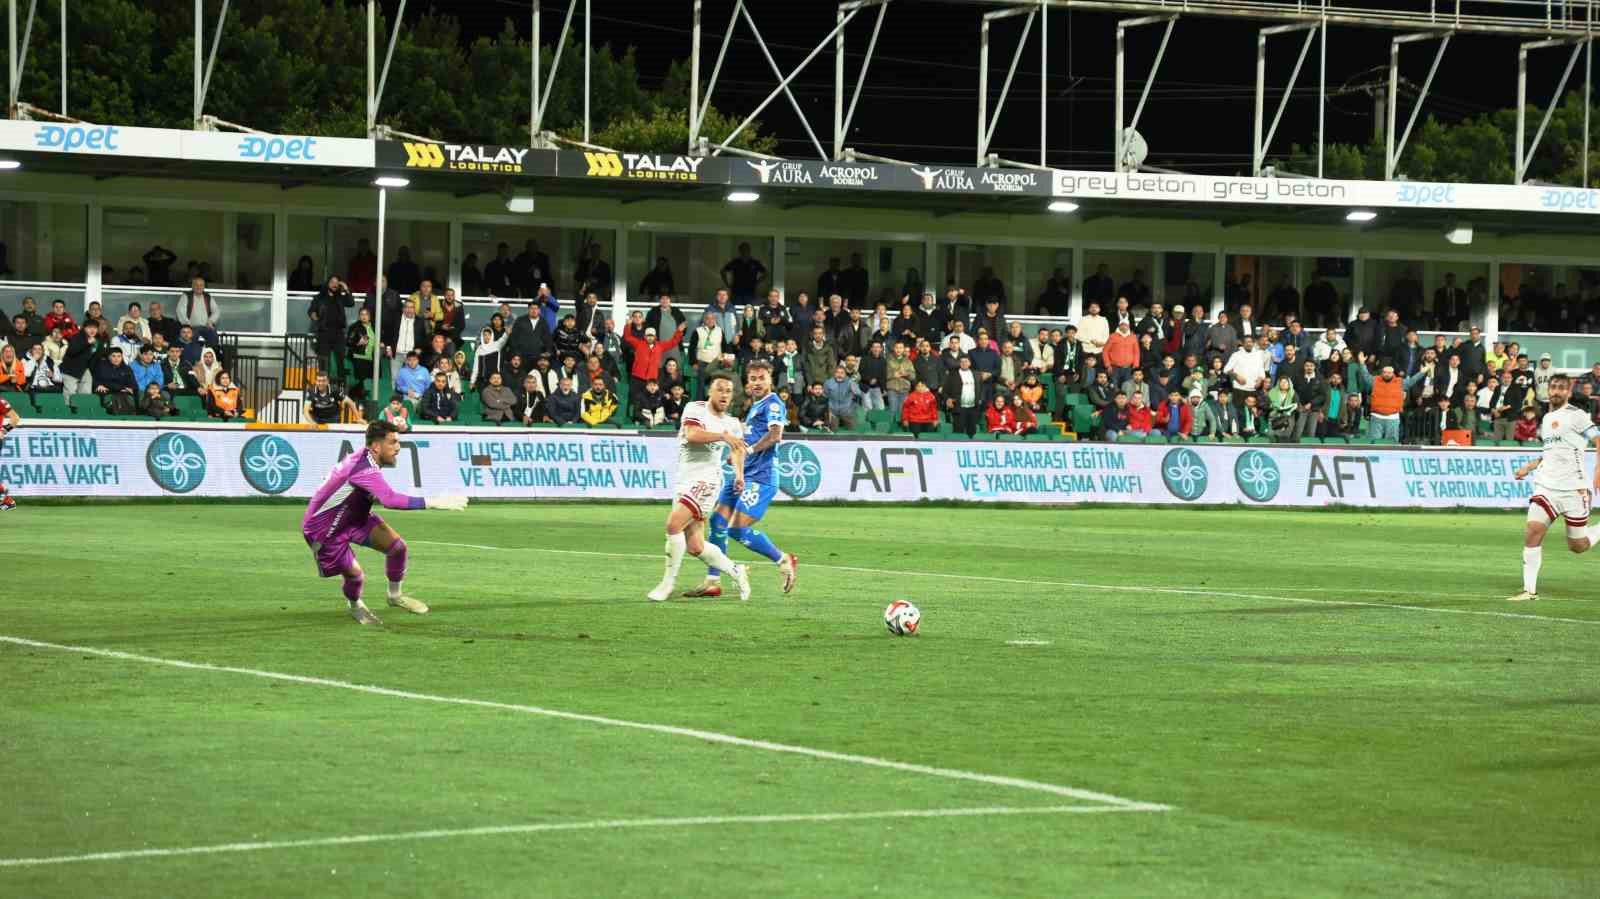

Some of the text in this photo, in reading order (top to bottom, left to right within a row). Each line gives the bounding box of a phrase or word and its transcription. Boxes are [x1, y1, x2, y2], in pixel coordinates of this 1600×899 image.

[40, 125, 118, 151] opet
[244, 136, 317, 161] opet
[444, 145, 529, 164] TALAY
[622, 152, 703, 171] TALAY
[449, 162, 523, 173] LOGISTICS
[627, 170, 698, 181] LOGISTICS
[772, 170, 813, 184] AURA
[782, 162, 803, 171] GRUP
[819, 164, 878, 181] ACROPOL
[945, 168, 966, 177] GRUP
[936, 176, 975, 190] AURA
[981, 171, 1037, 187] ACROPOL
[1060, 173, 1196, 195] grey beton
[1213, 178, 1346, 201] grey beton
[1400, 184, 1456, 204] opet
[1545, 189, 1598, 211] opet
[28, 432, 98, 457] EĞİTİM
[457, 439, 650, 464] ULUSLARARASI EĞİTİM
[956, 448, 1126, 470] ULUSLARARASI EĞİTİM
[1401, 457, 1507, 477] ULUSLARARASI
[63, 464, 118, 485] VAKFI
[460, 467, 667, 490] VE YARDIMLAŞMA VAKFI
[850, 448, 933, 493] AFT
[1307, 455, 1379, 499] AFT
[960, 473, 1143, 494] VE YARDIMLAŞMA VAKFI
[1406, 481, 1534, 502] VE YARDIMLAŞMA
